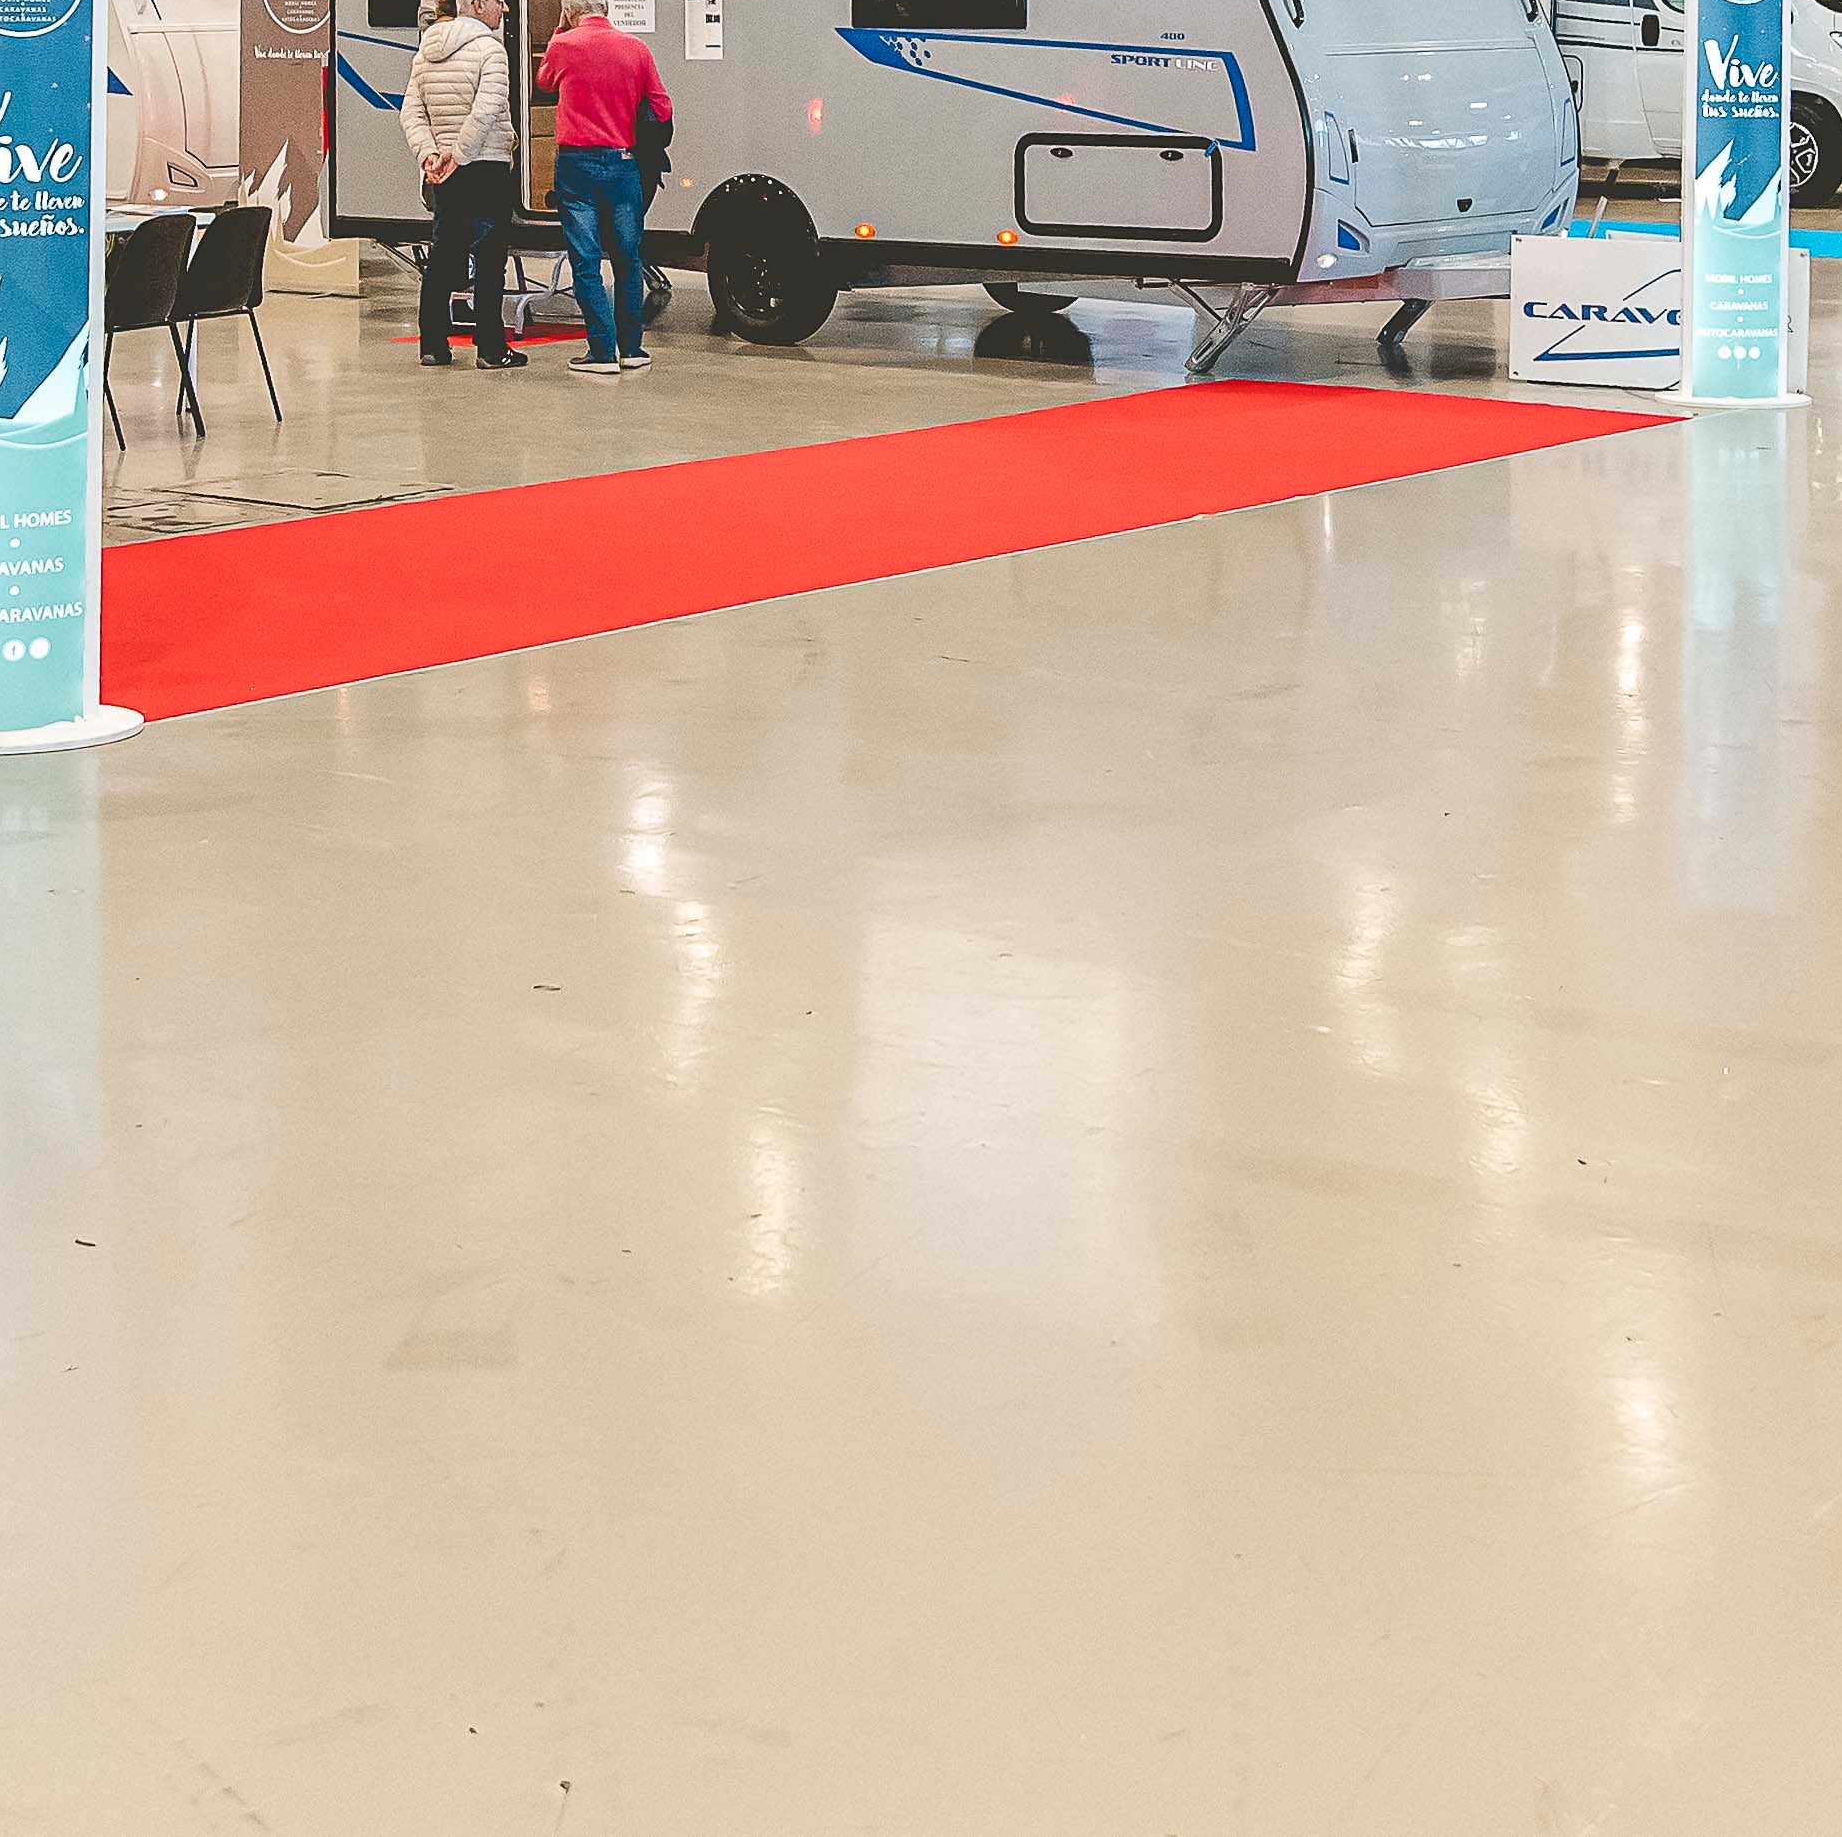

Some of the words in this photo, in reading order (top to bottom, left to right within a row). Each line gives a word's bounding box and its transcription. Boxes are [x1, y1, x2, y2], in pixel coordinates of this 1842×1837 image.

[1111, 54, 1172, 67] SPORT
[1175, 59, 1219, 71] LINE
[1704, 34, 1779, 91] Vive
[1701, 89, 1737, 104] donde
[1737, 90, 1750, 104] te
[10, 189, 32, 211] te
[34, 190, 85, 211] lleven
[1709, 300, 1769, 312] CARAVANAS
[13, 509, 73, 529] HOMES
